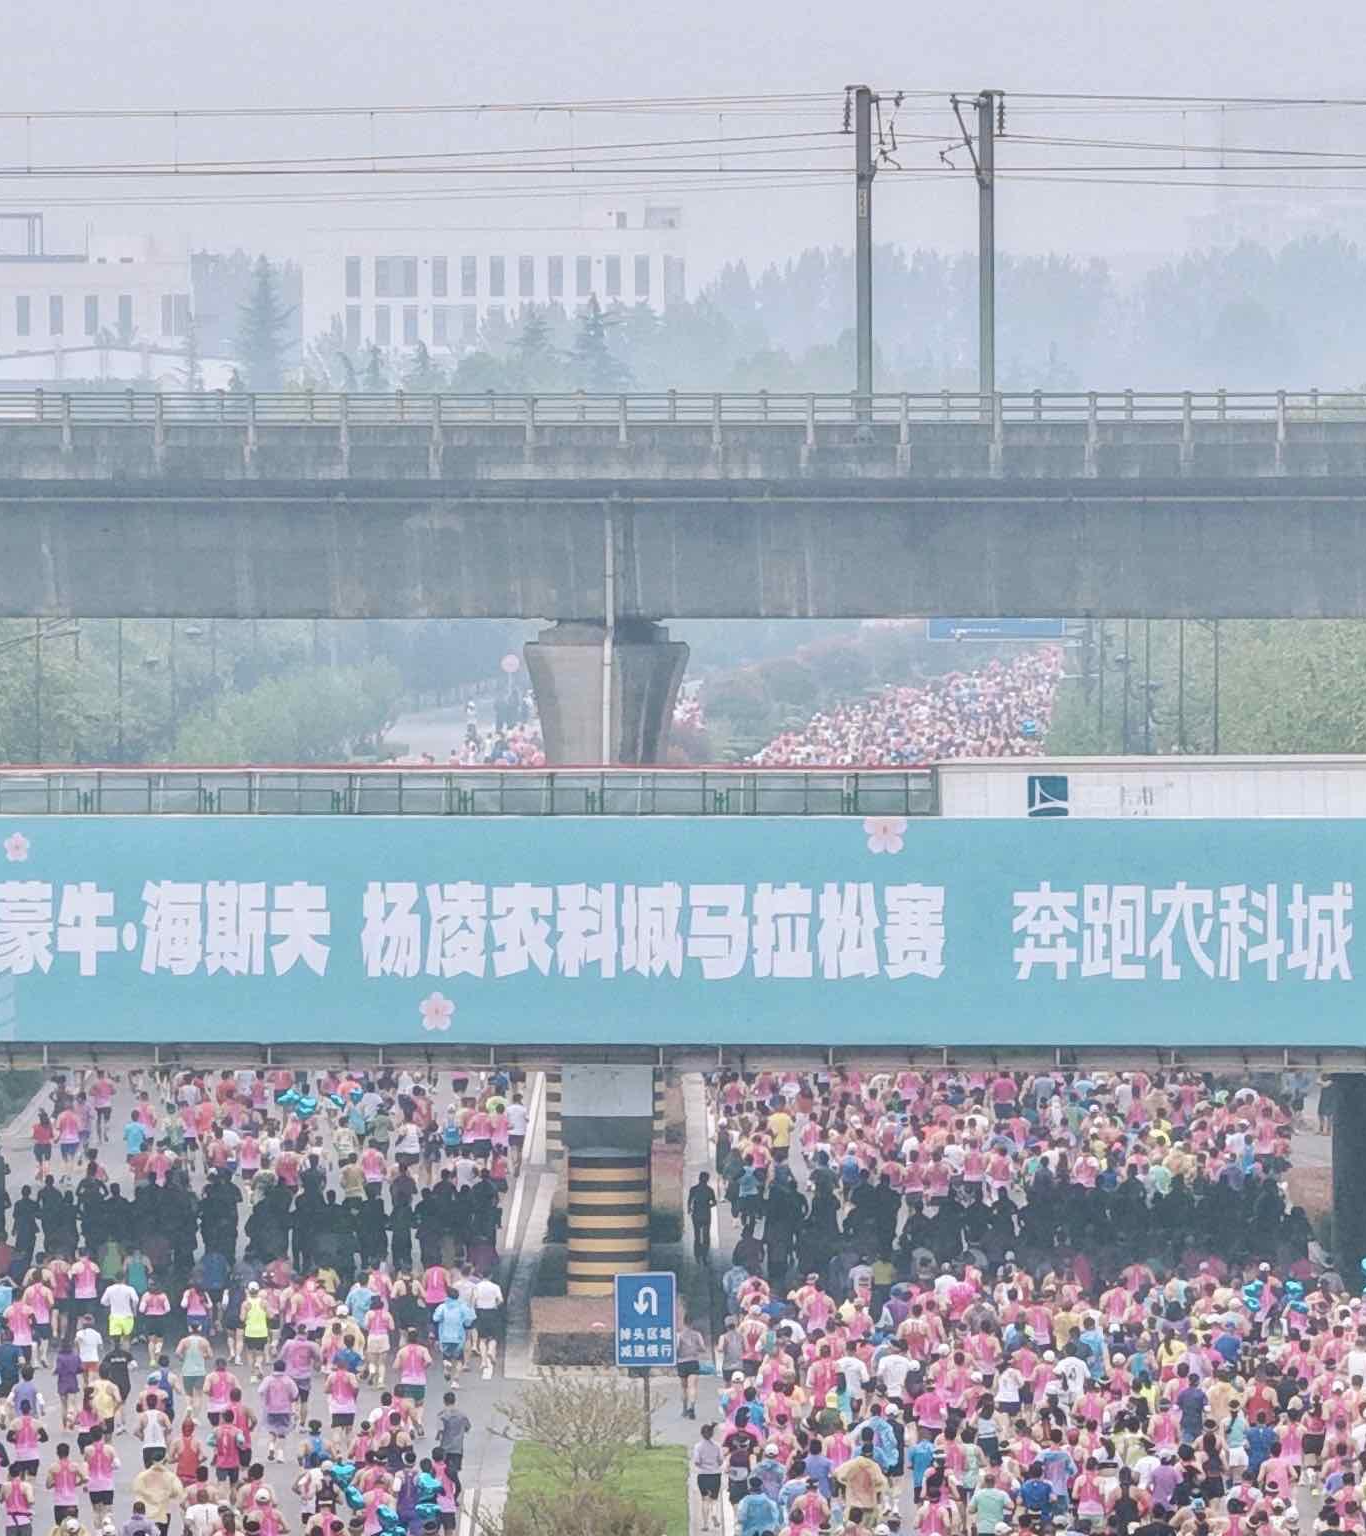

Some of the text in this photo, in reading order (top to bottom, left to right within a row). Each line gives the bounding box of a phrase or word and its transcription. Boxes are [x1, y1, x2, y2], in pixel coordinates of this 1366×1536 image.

[360, 880, 946, 980] 杨凌农科城马拉松赛
[1012, 881, 1353, 981] 奔跑农科城
